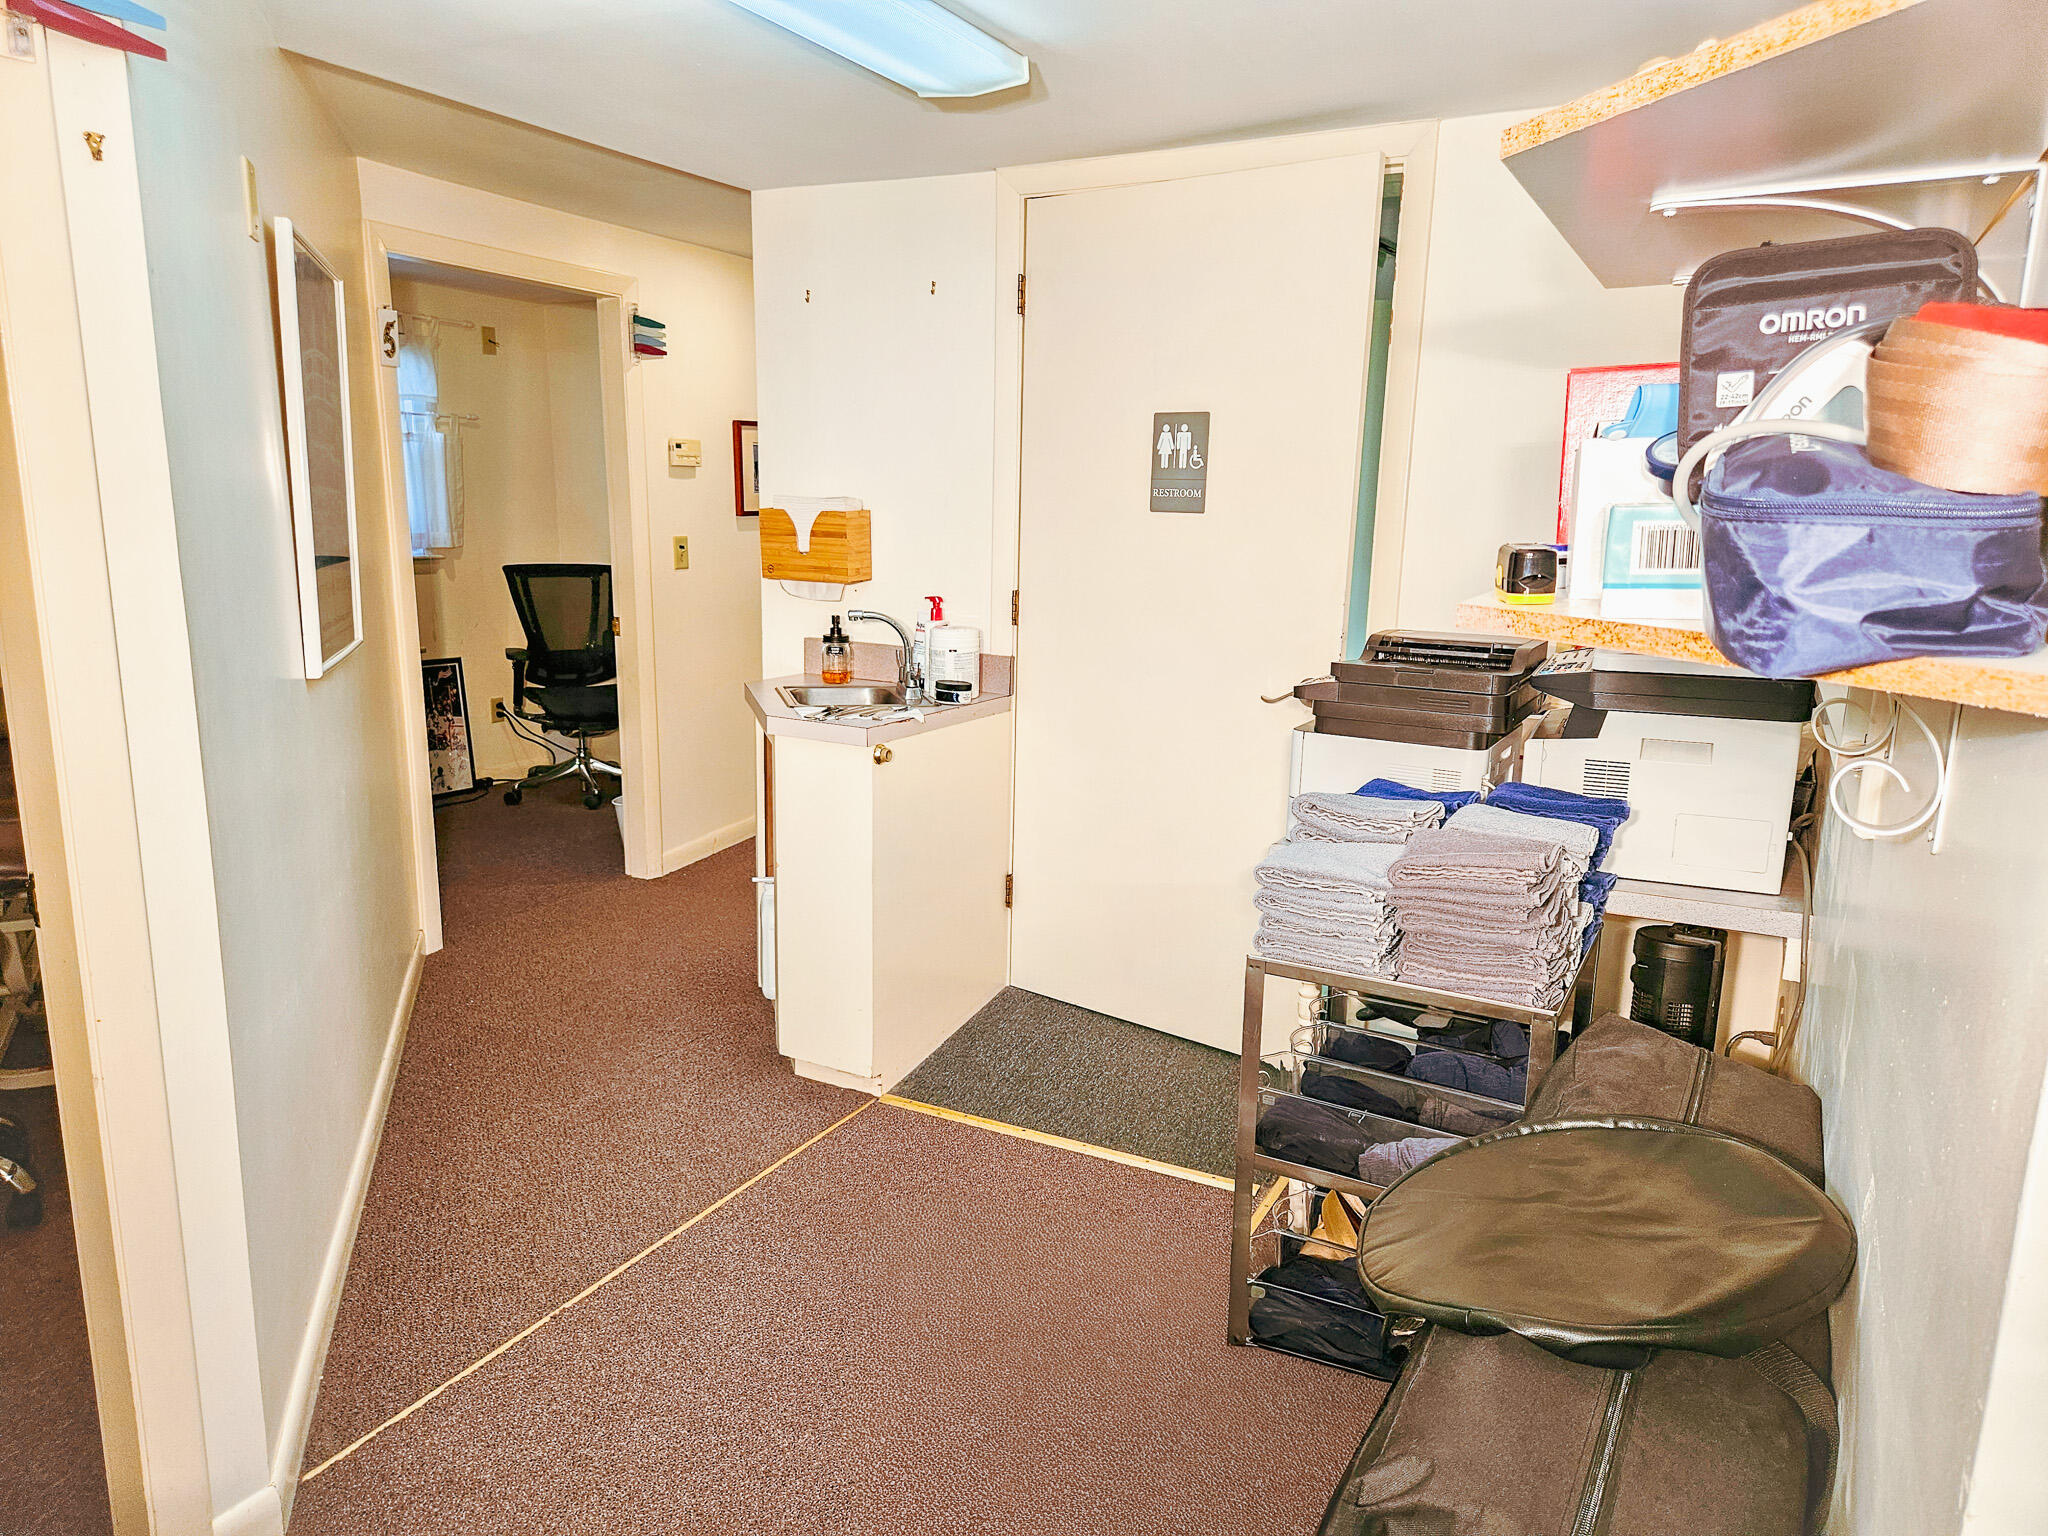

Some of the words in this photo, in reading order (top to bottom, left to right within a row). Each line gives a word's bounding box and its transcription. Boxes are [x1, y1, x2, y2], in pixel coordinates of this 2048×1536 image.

[1759, 305, 1867, 335] OMRON
[383, 320, 397, 359] 5
[1152, 488, 1202, 498] RESTROOM
